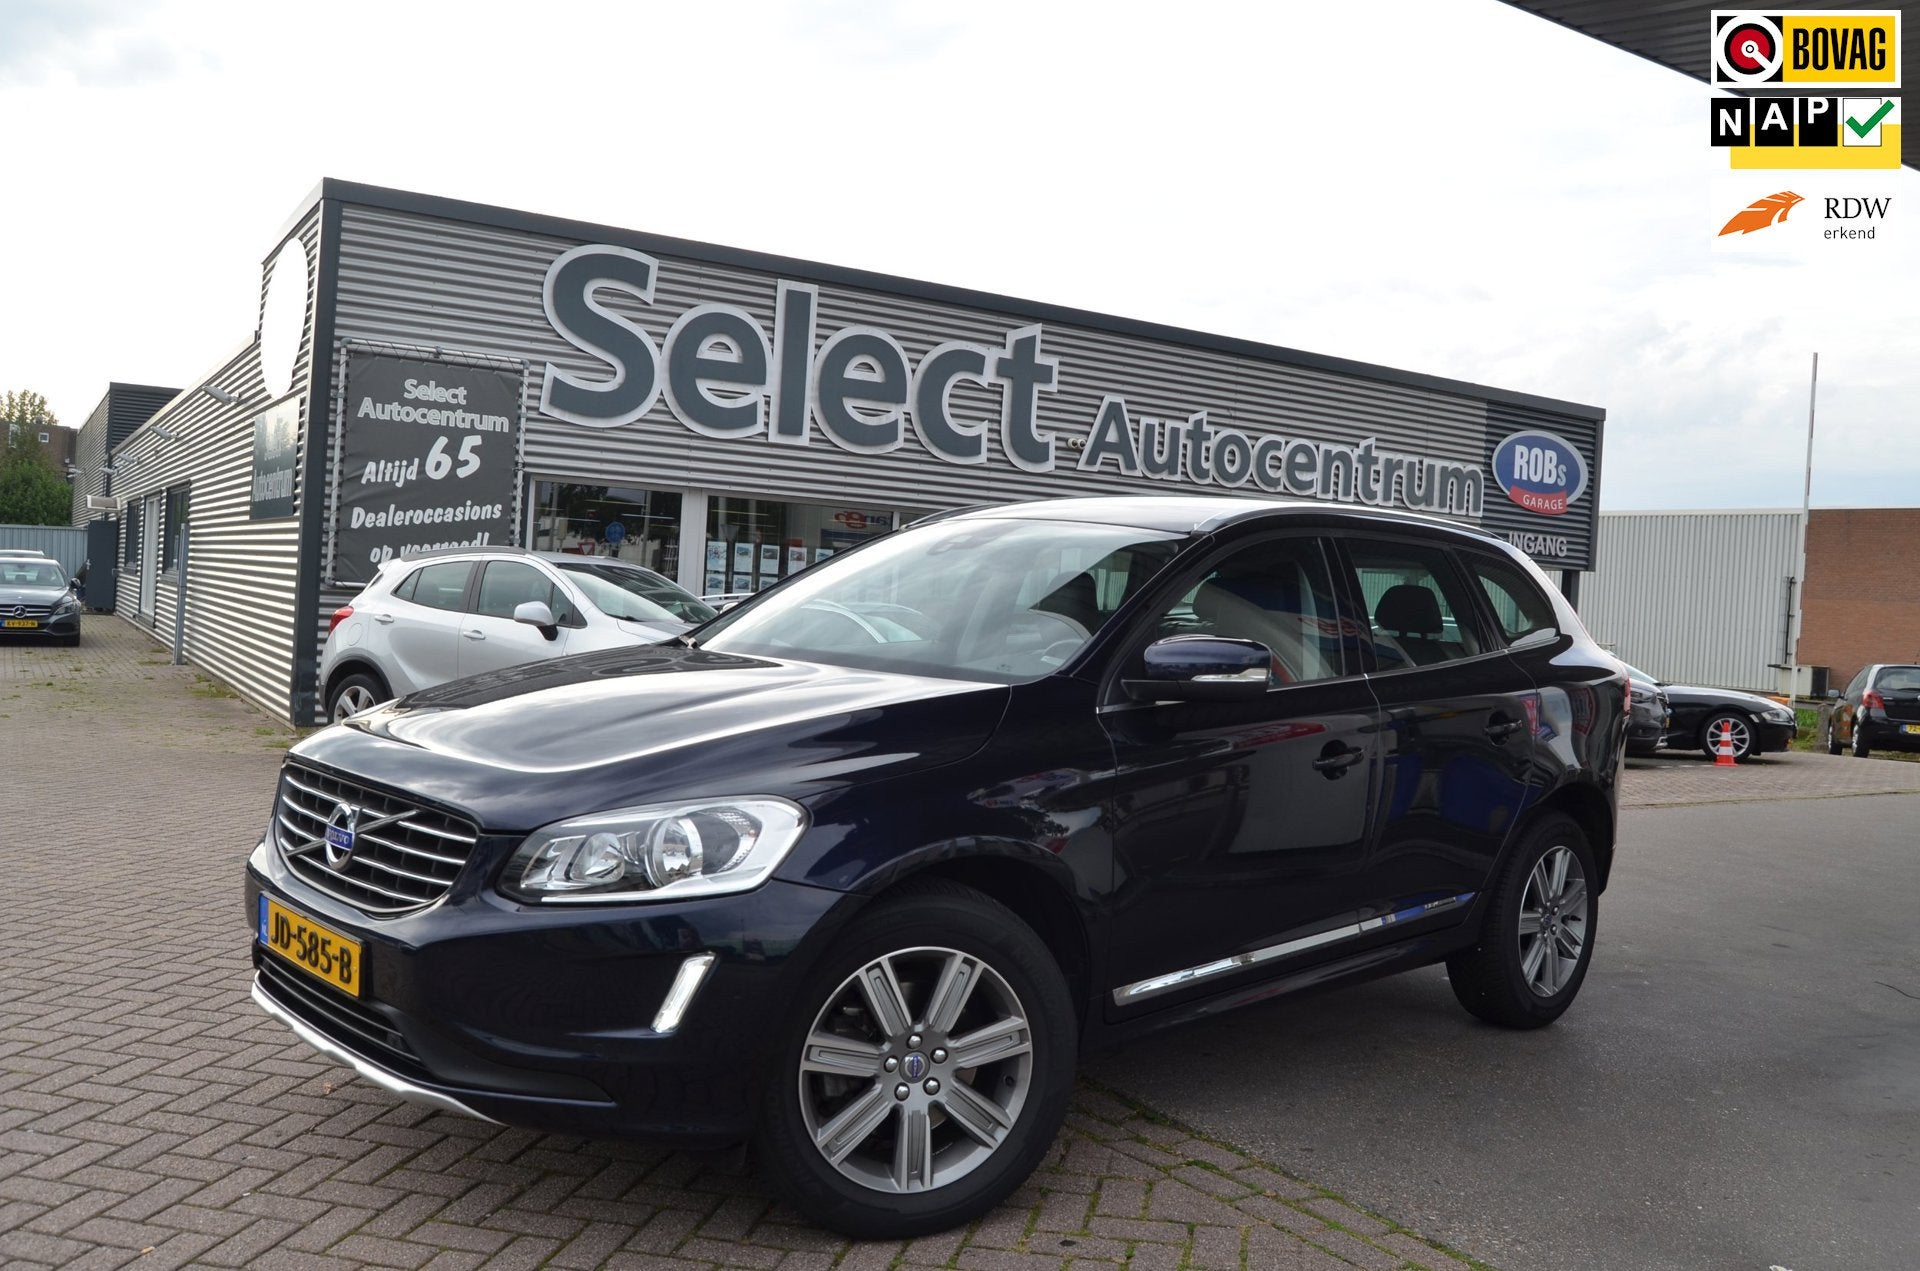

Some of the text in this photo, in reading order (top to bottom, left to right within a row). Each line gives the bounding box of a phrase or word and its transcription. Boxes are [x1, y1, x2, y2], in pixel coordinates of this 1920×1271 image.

[403, 379, 467, 405] Select
[540, 244, 1483, 517] Select Autocentrum
[357, 397, 509, 432] Autocentrum
[361, 435, 483, 488] Altijd 65
[1513, 444, 1567, 487] ROBs
[350, 500, 502, 529] Dealeroccasions
[1523, 494, 1564, 510] GARAGE
[1508, 531, 1567, 557] INGANG
[270, 912, 352, 985] JD-585-B
